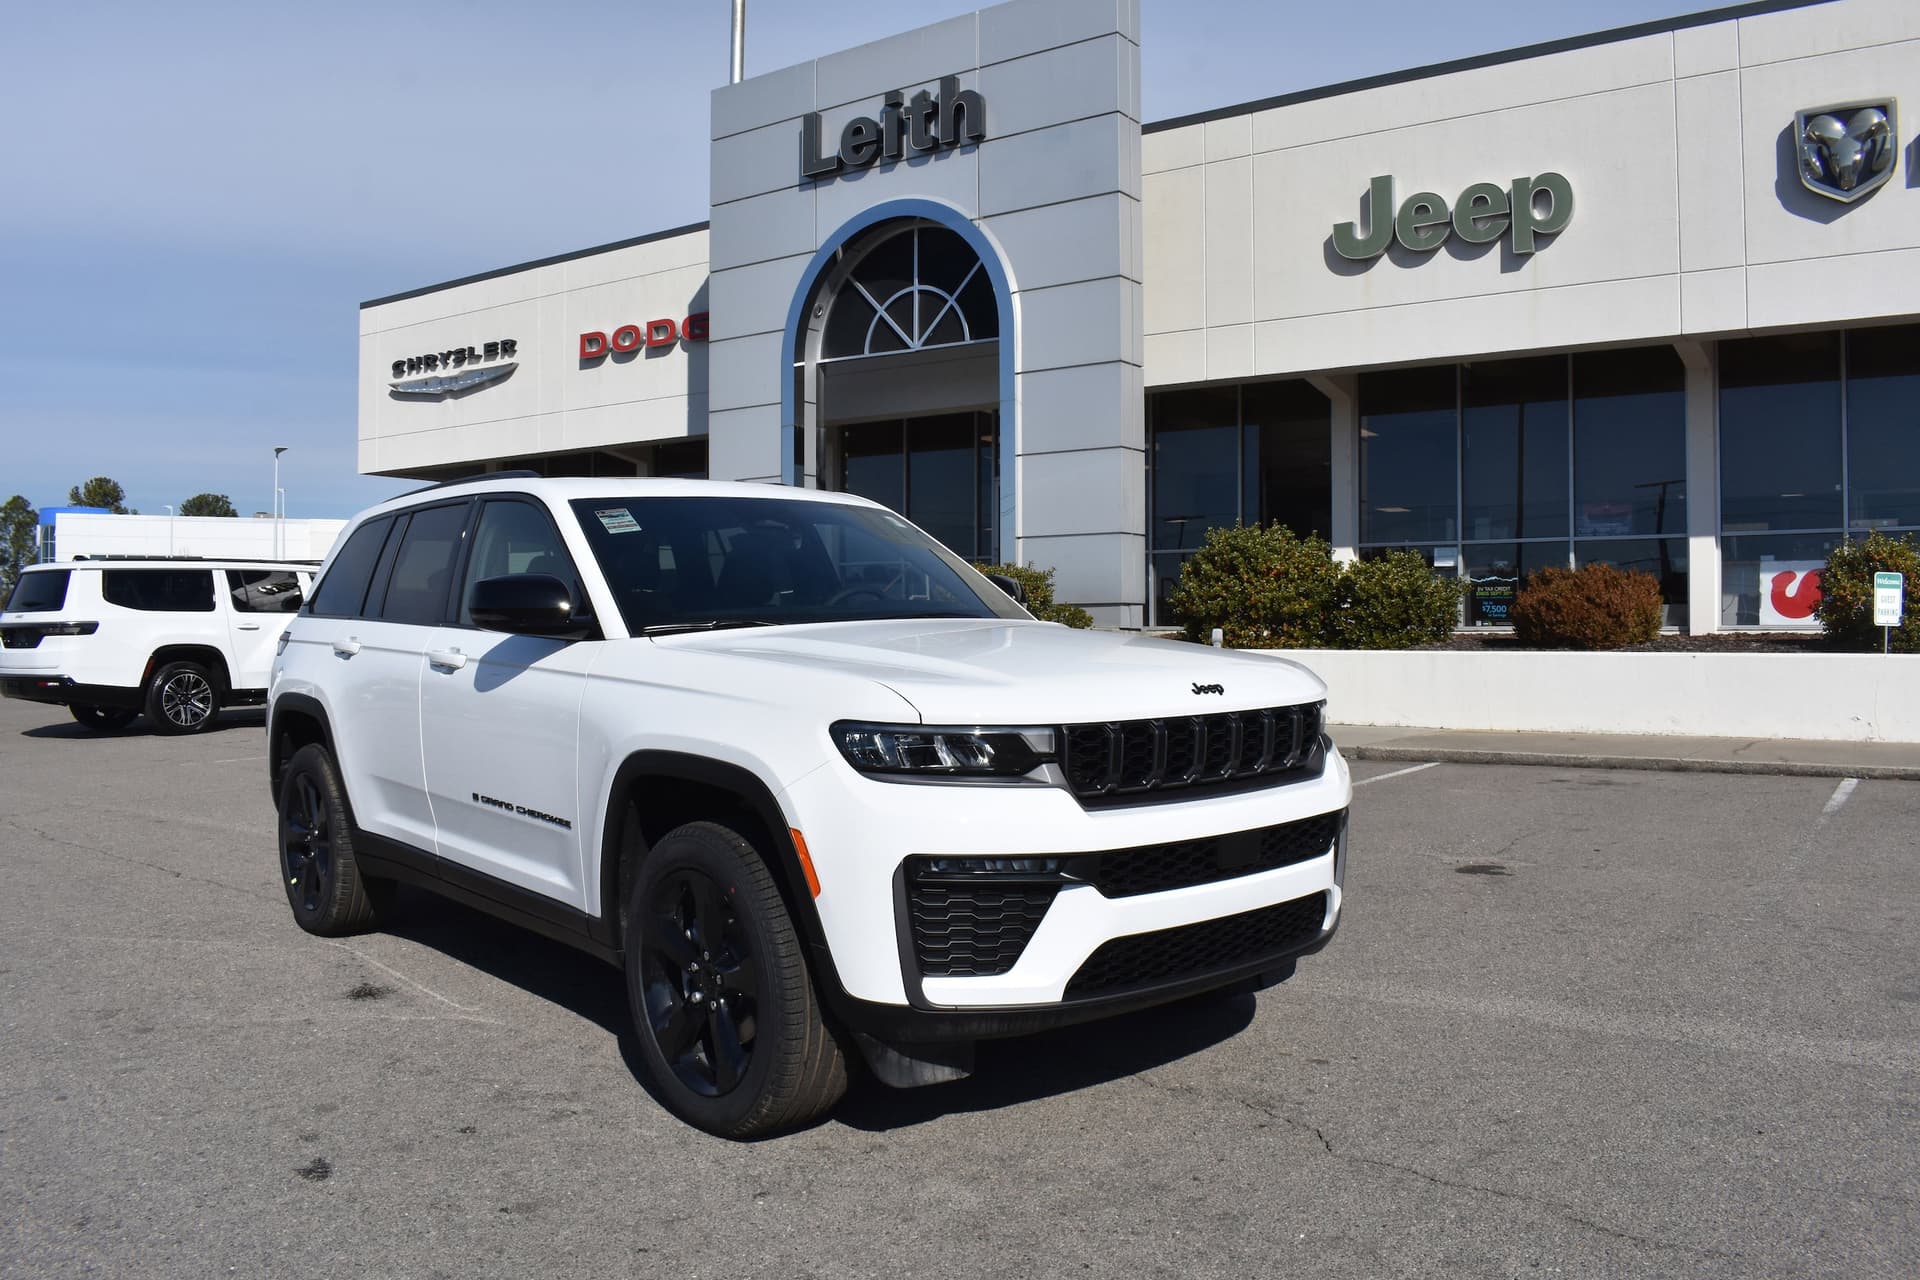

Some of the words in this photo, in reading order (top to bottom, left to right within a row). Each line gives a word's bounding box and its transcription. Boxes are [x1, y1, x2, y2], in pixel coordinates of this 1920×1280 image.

[802, 75, 986, 177] Leith
[1332, 172, 1574, 260] Jeep
[392, 338, 517, 377] CHRYSLER
[1877, 608, 1898, 617] PARKING
[1880, 595, 1896, 604] GUEST
[1191, 682, 1224, 696] Jeep
[481, 795, 514, 812] GRAND
[516, 805, 572, 830] CHEROKEE
